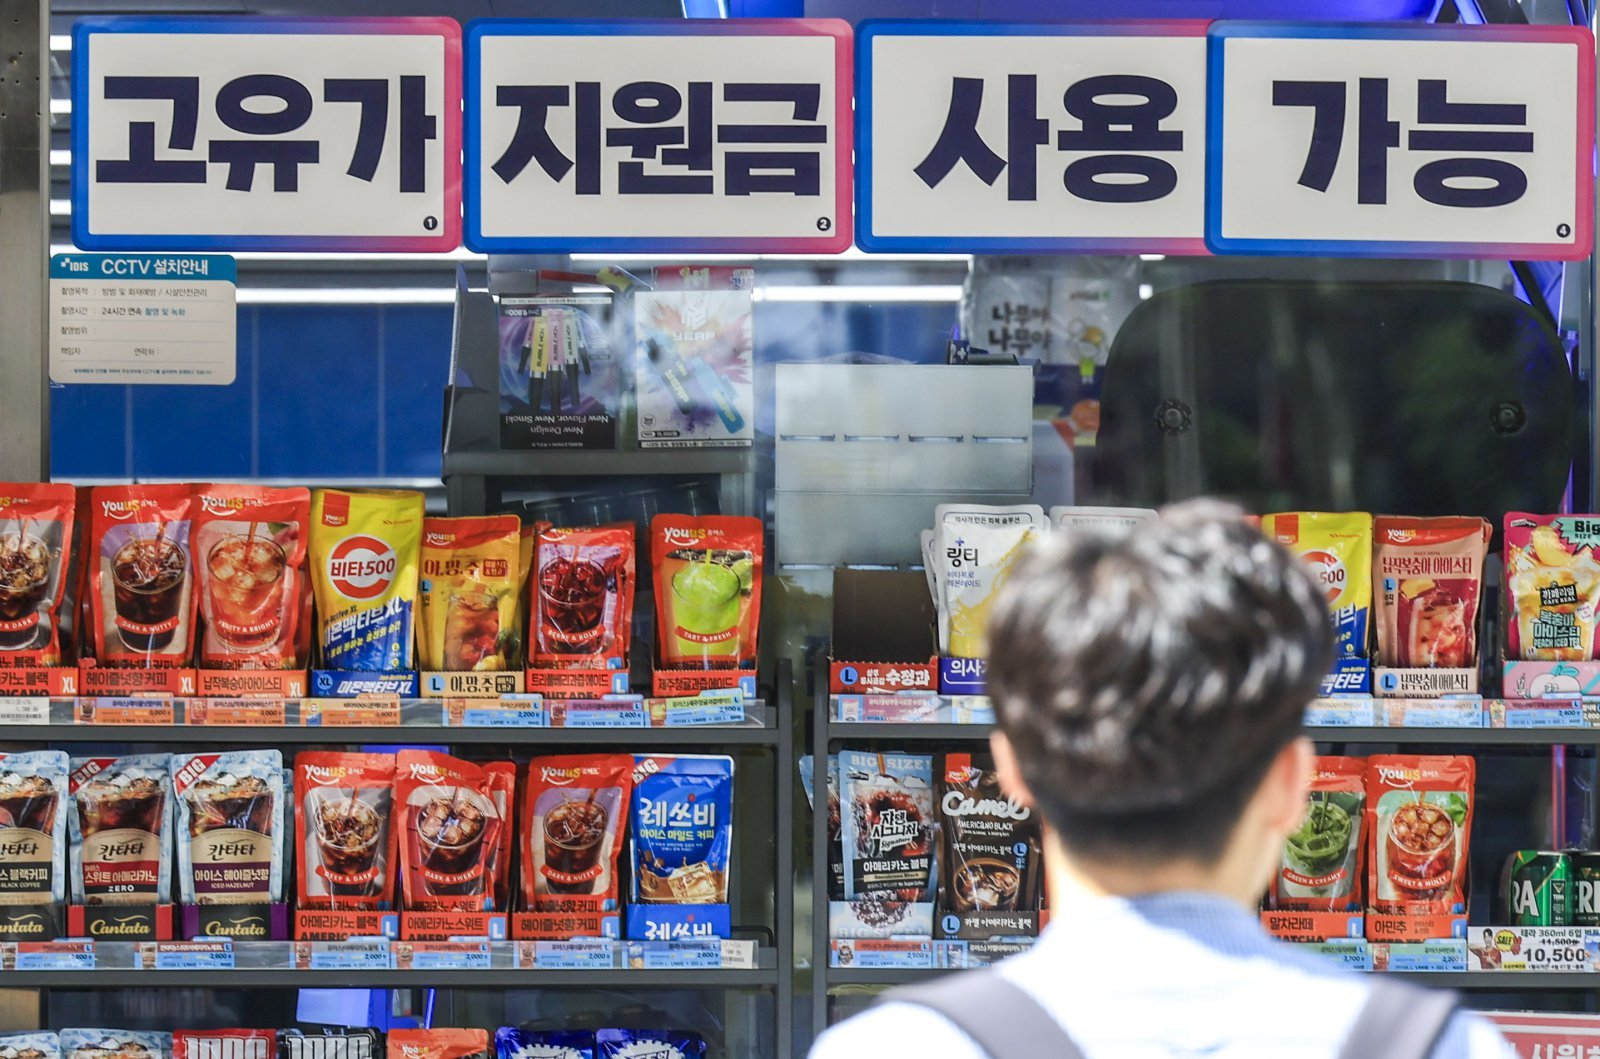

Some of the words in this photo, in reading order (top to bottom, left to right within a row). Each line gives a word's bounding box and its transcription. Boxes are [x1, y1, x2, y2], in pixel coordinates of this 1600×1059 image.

[96, 74, 437, 192] 고유가
[491, 81, 827, 196] 지원금
[913, 74, 1184, 203] 사용
[1272, 77, 1534, 208] 가능
[69, 261, 89, 272] IDIS
[101, 259, 151, 275] CCTV
[153, 259, 208, 276] 설치안내
[101, 307, 126, 317] 24시간
[535, 414, 555, 424] New
[588, 414, 608, 424] New
[530, 425, 562, 436] Design
[565, 426, 584, 435] New
[101, 499, 140, 518] youus
[664, 526, 706, 544] youus
[946, 547, 979, 568] 링티
[330, 558, 396, 579] 비타500
[1433, 557, 1472, 576] 아이스티
[1540, 609, 1575, 627] 복숭아
[249, 620, 274, 633] BRIGHT
[1533, 622, 1581, 638] 아이스티
[709, 632, 732, 642] FRESH
[25, 672, 49, 686] 블랙
[62, 676, 77, 693] XL
[86, 671, 143, 686] 헤이즐넛향
[144, 671, 168, 686] 커피
[180, 676, 195, 694] XL
[319, 677, 331, 687] XL
[615, 675, 626, 692] L
[886, 668, 930, 687] 수정과
[290, 681, 304, 697] XL
[399, 680, 413, 695] XL
[743, 680, 753, 697] L
[851, 755, 879, 767] BIG
[72, 760, 101, 785] BIG
[178, 757, 206, 786] BIG
[304, 765, 347, 781] youus
[541, 766, 581, 782] youus
[632, 758, 660, 784] BIG
[1378, 767, 1420, 784] youus
[638, 798, 716, 828] 레쓰비
[994, 821, 1014, 831] BLACK
[640, 829, 666, 840] 아이스
[667, 829, 695, 841] 마일드
[696, 830, 715, 840] 커피
[880, 836, 912, 850] Signature
[100, 842, 145, 861] 칸타타
[208, 843, 256, 862] 칸타타
[863, 860, 910, 872] 아메리카노
[911, 857, 929, 870] 블랙
[9, 868, 49, 882] 블랙커피
[85, 870, 111, 884] 스위트
[112, 868, 158, 883] 아메리카노
[195, 869, 223, 882] 아이스
[223, 868, 270, 882] 헤이즐넛향
[90, 918, 151, 936] Cantata
[205, 920, 266, 936] Cantata
[300, 915, 355, 929] 아메리카노
[356, 916, 378, 928] 블랙
[407, 917, 455, 931] 아메리카노
[455, 917, 485, 931] 스위트
[520, 918, 576, 932] 헤이즐넛향
[576, 918, 599, 931] 커피
[644, 920, 713, 940] 레쓰비
[981, 918, 1018, 930] 아메리카노
[1017, 918, 1032, 930] 블랙
[1269, 916, 1314, 931] 말차라떼
[1374, 919, 1407, 935] 아민추
[1496, 935, 1513, 946] SALE
[1521, 929, 1536, 938] 테라
[1538, 929, 1567, 937] 360ml
[1568, 929, 1582, 938] 6입
[1523, 948, 1585, 964] 10,500
